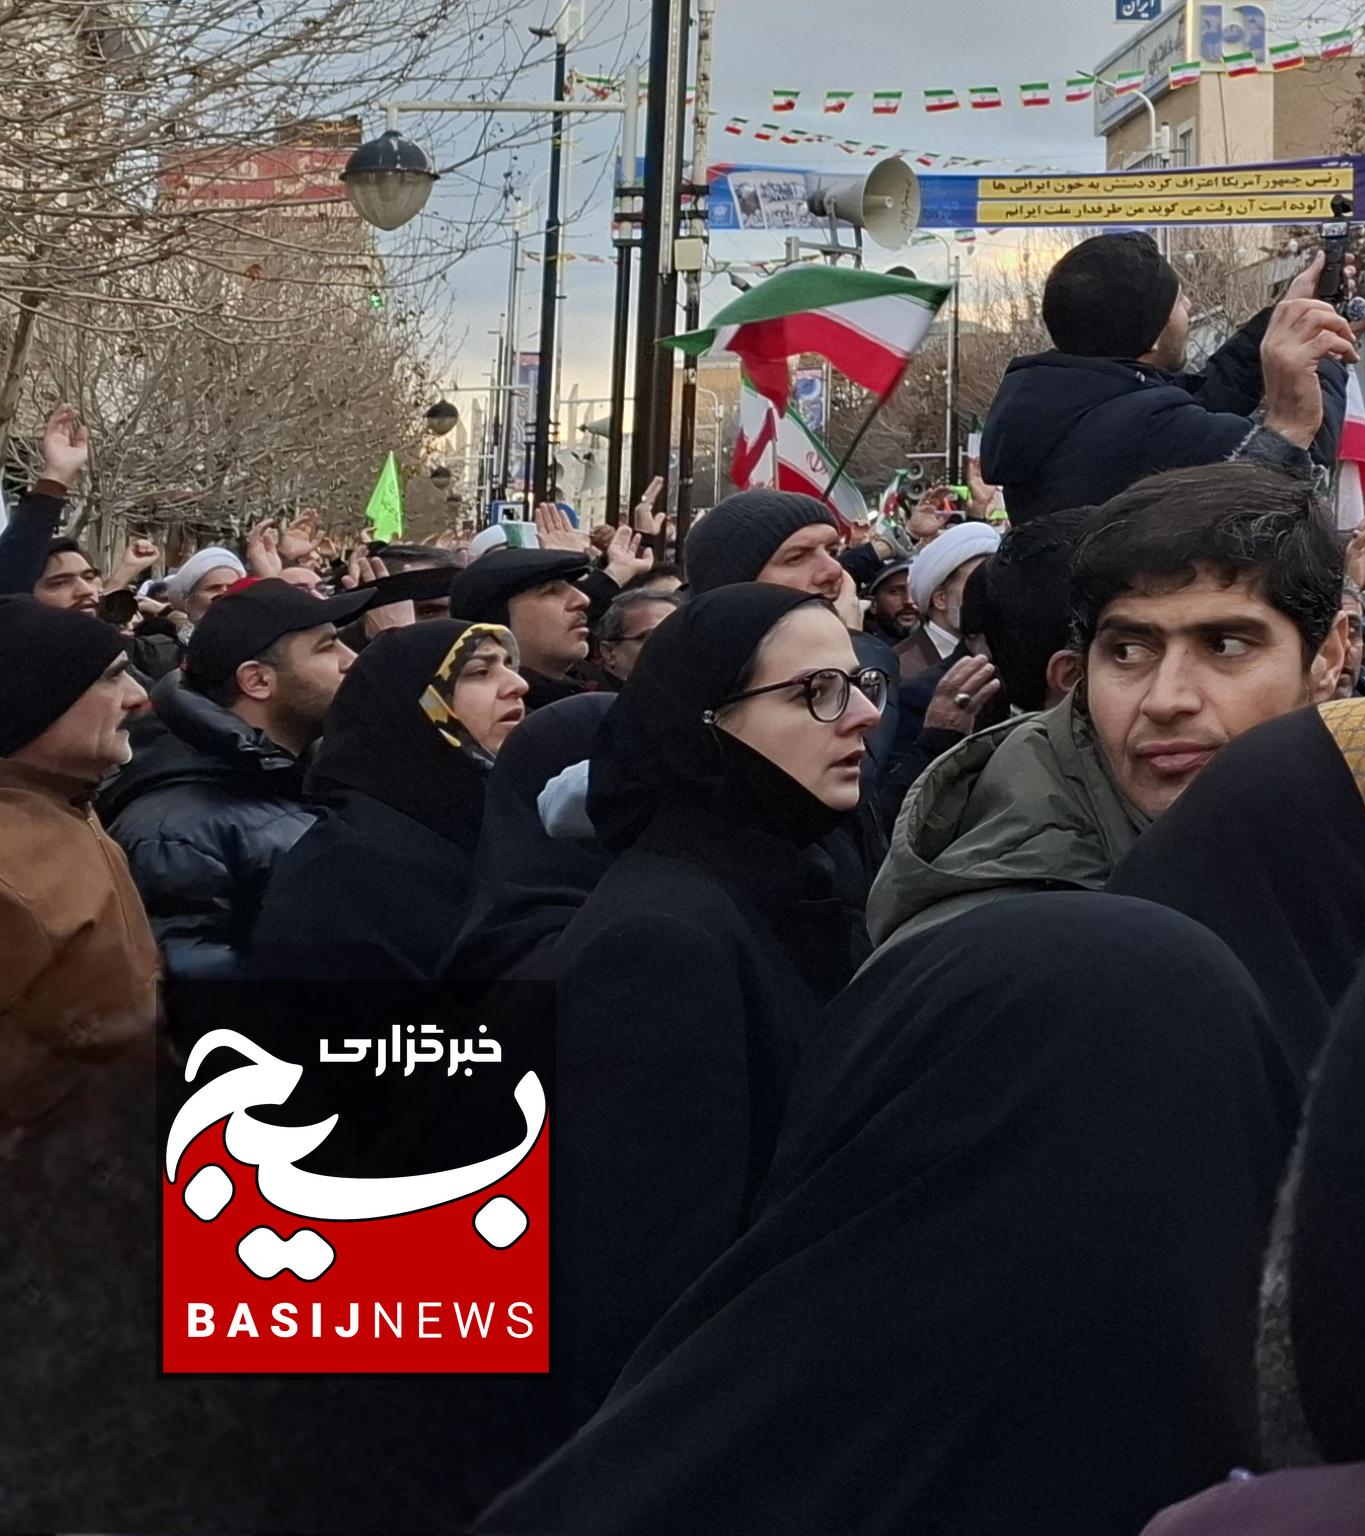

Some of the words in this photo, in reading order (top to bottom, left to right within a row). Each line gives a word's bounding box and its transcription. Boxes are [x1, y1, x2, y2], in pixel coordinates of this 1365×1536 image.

[992, 179, 1007, 191] ها
[1009, 179, 1051, 194] ایرانی
[1053, 180, 1084, 193] خون
[1087, 181, 1100, 192] به
[1103, 178, 1145, 192] دستش
[1147, 177, 1173, 192] کرد
[1175, 175, 1219, 191] اعتراف
[1263, 175, 1301, 190] جمهور
[1305, 171, 1340, 189] رئیس
[1005, 204, 1042, 220] ایرانم
[1044, 204, 1072, 216] ملت
[1075, 203, 1123, 219] طرفدار
[1125, 205, 1145, 218] من
[1181, 203, 1202, 217] می
[1205, 201, 1233, 216] وقت
[1236, 199, 1257, 216] آن
[1258, 199, 1287, 214] است
[1289, 197, 1326, 215] آلوده
